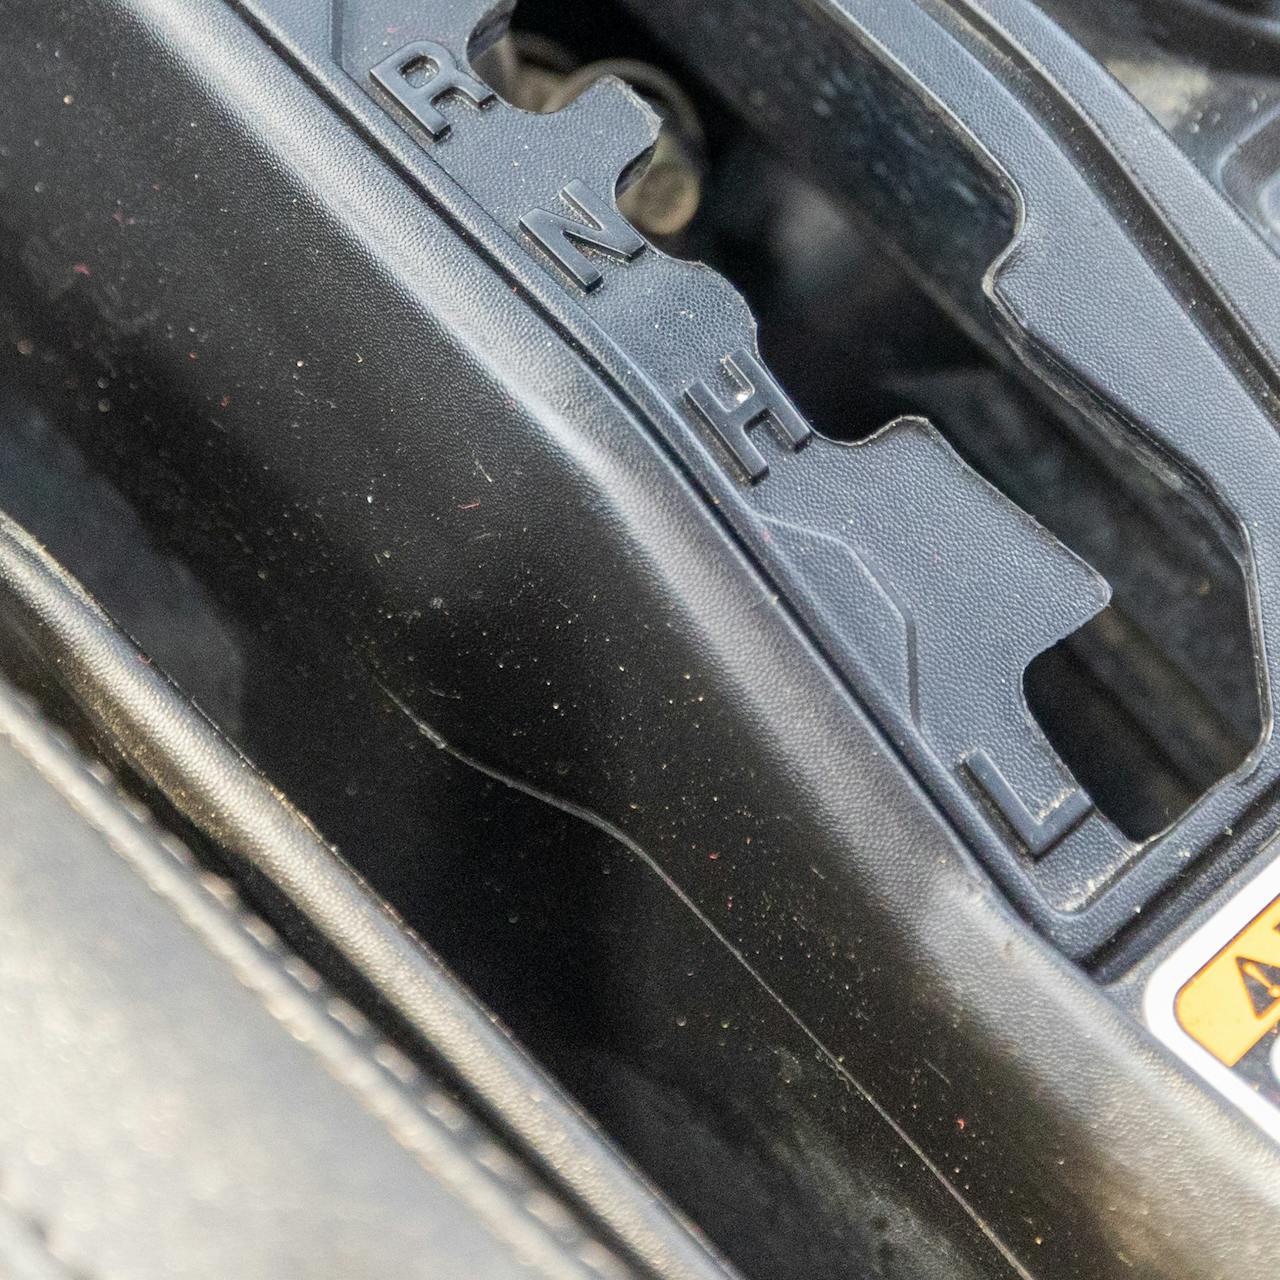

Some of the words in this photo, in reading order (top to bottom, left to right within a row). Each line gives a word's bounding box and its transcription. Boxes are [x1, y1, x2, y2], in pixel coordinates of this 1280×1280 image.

[369, 40, 497, 140] R
[520, 179, 647, 293] N
[684, 348, 812, 484] H
[960, 748, 1093, 863] L
